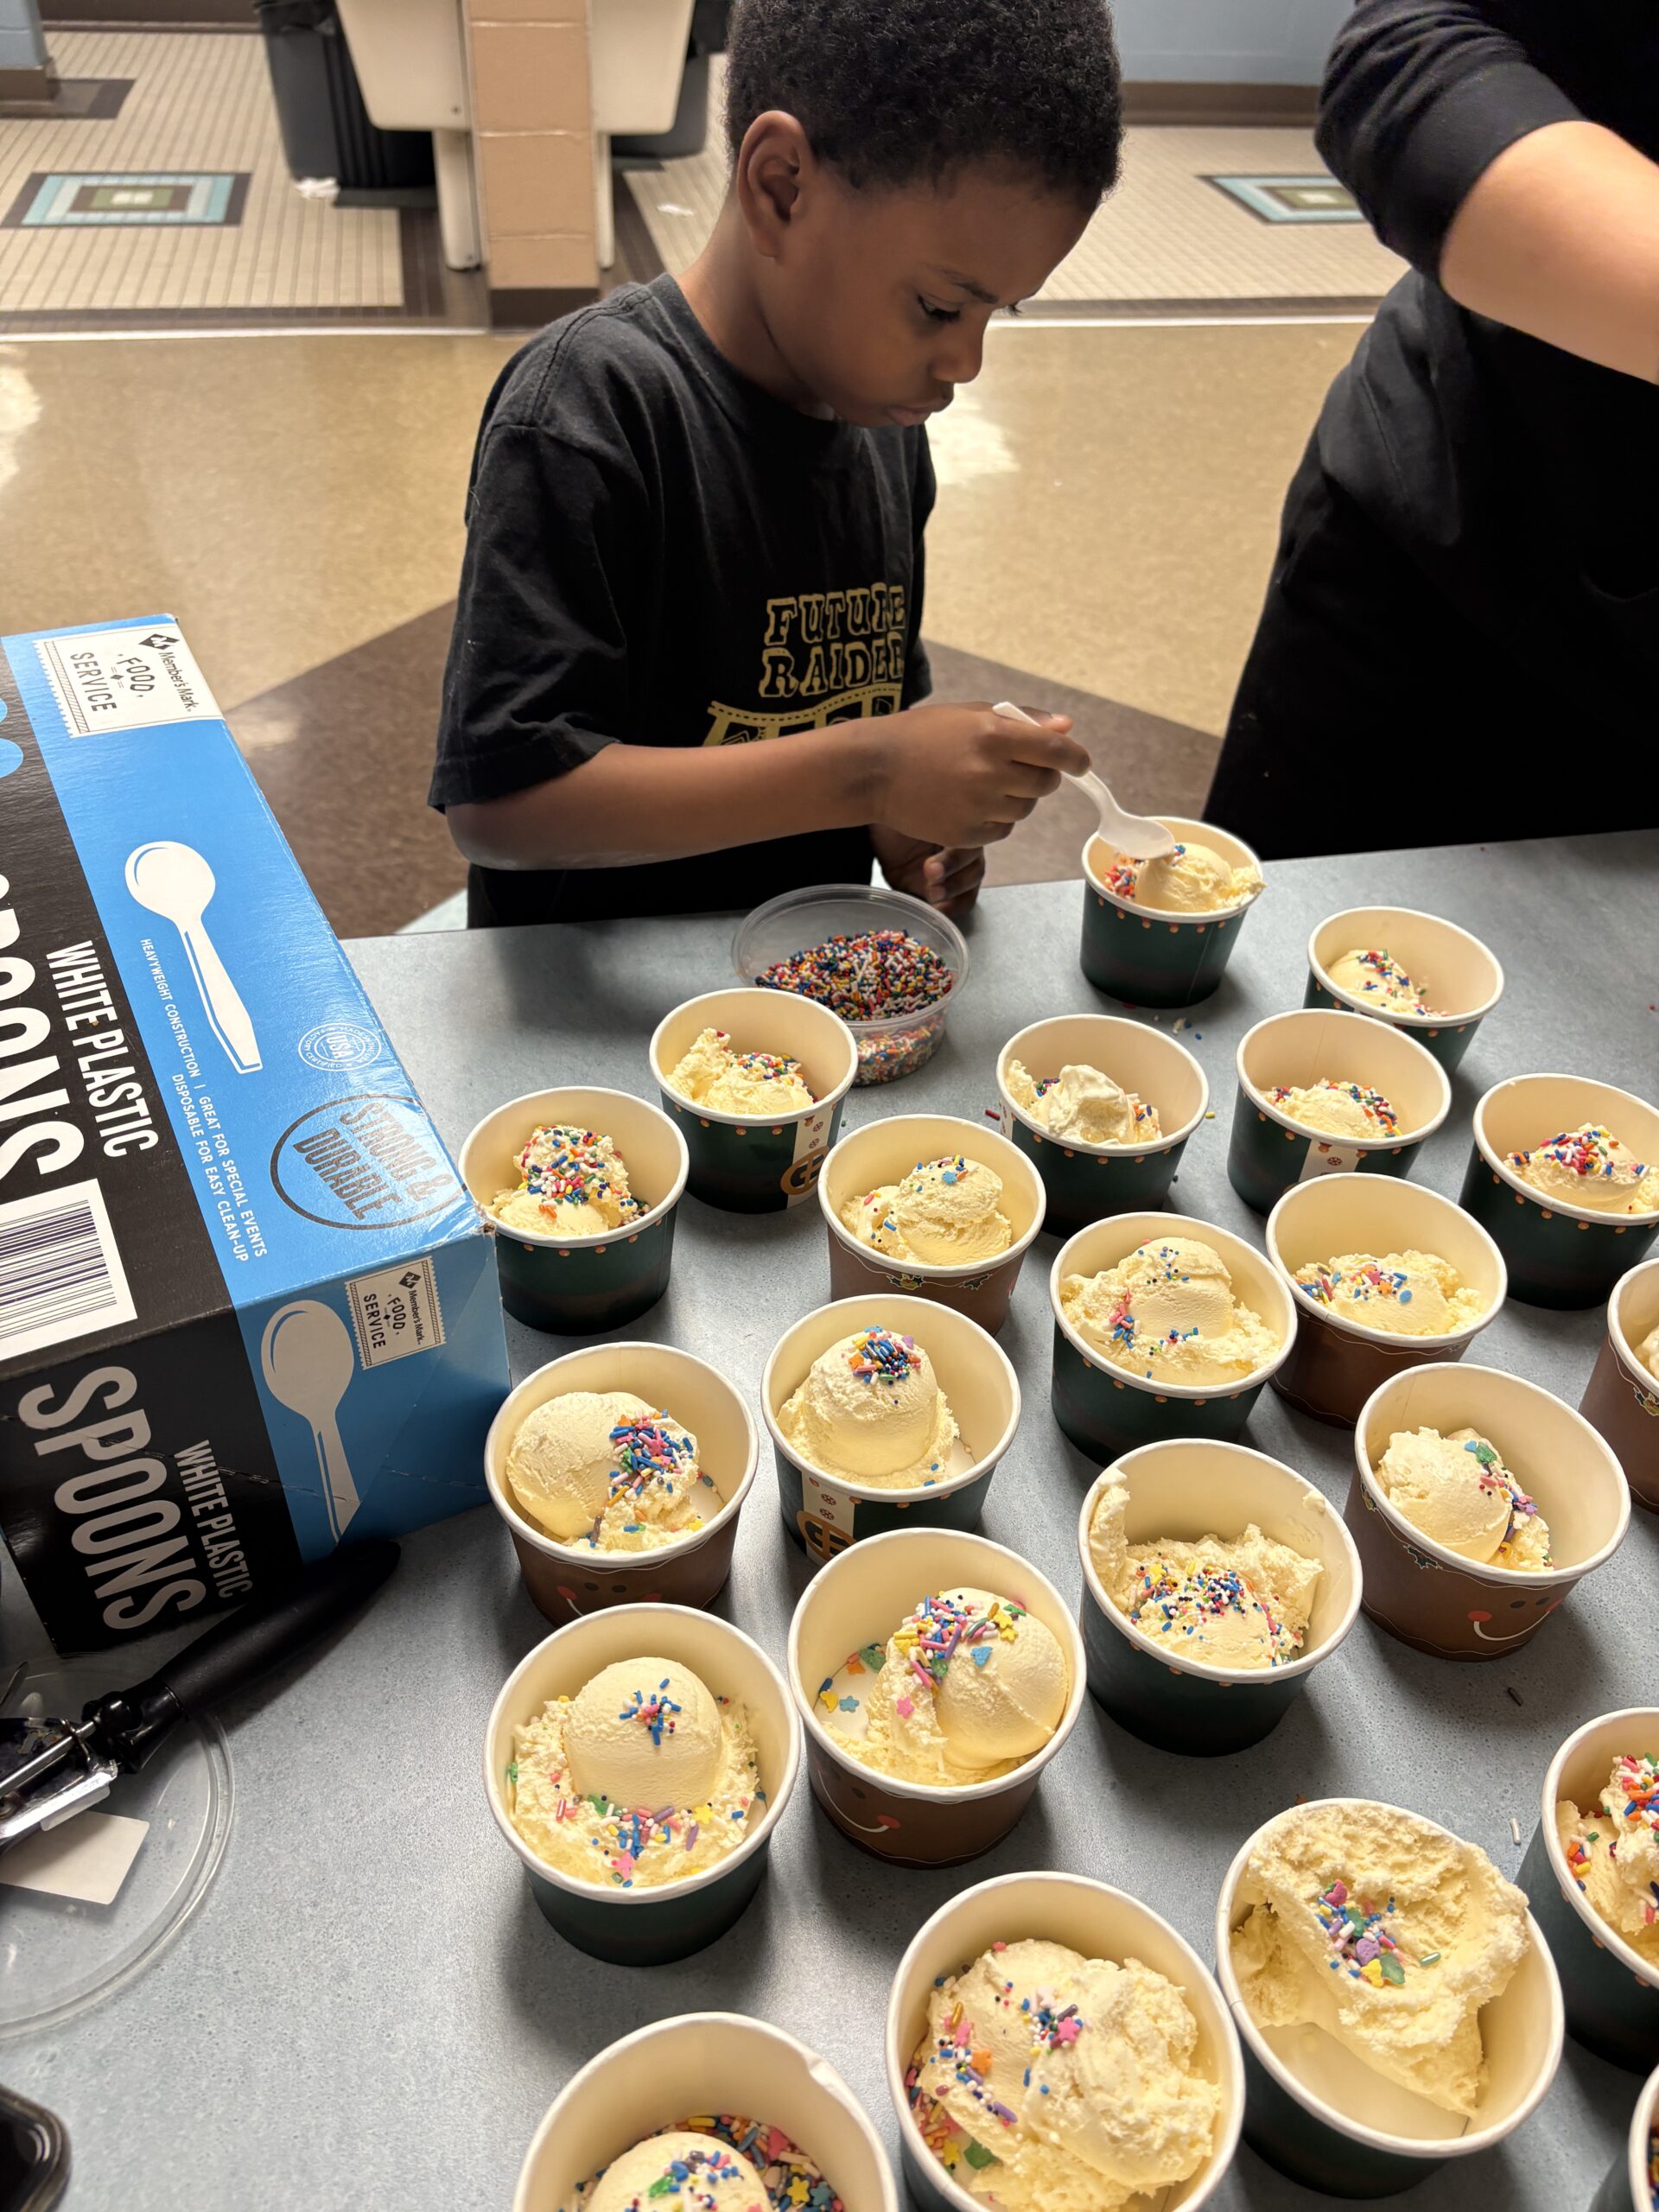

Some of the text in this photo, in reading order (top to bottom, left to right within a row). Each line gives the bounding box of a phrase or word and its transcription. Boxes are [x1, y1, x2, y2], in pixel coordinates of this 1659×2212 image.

[70, 652, 118, 712] SERVICE
[116, 657, 156, 692] FOOD
[158, 652, 189, 689] Member's
[46, 939, 159, 1160] WHITE PLASTIC
[327, 1035, 354, 1058] USA
[140, 938, 268, 1258] HEAVYWEIGHT CONSTRUCTION GREAT FOR SPECIAL EVENTS
[172, 1073, 249, 1262] DISPOSABLE FOR EASY CLEAN-UP
[292, 1128, 401, 1221] DURABLE
[339, 1102, 454, 1202] STRONG &
[364, 1294, 386, 1349] SERVICE
[387, 1297, 407, 1330] FOOD
[409, 1290, 420, 1324] Member's
[18, 1365, 207, 1630] SPOONS
[174, 1439, 253, 1599] WHITE PLASTIC
